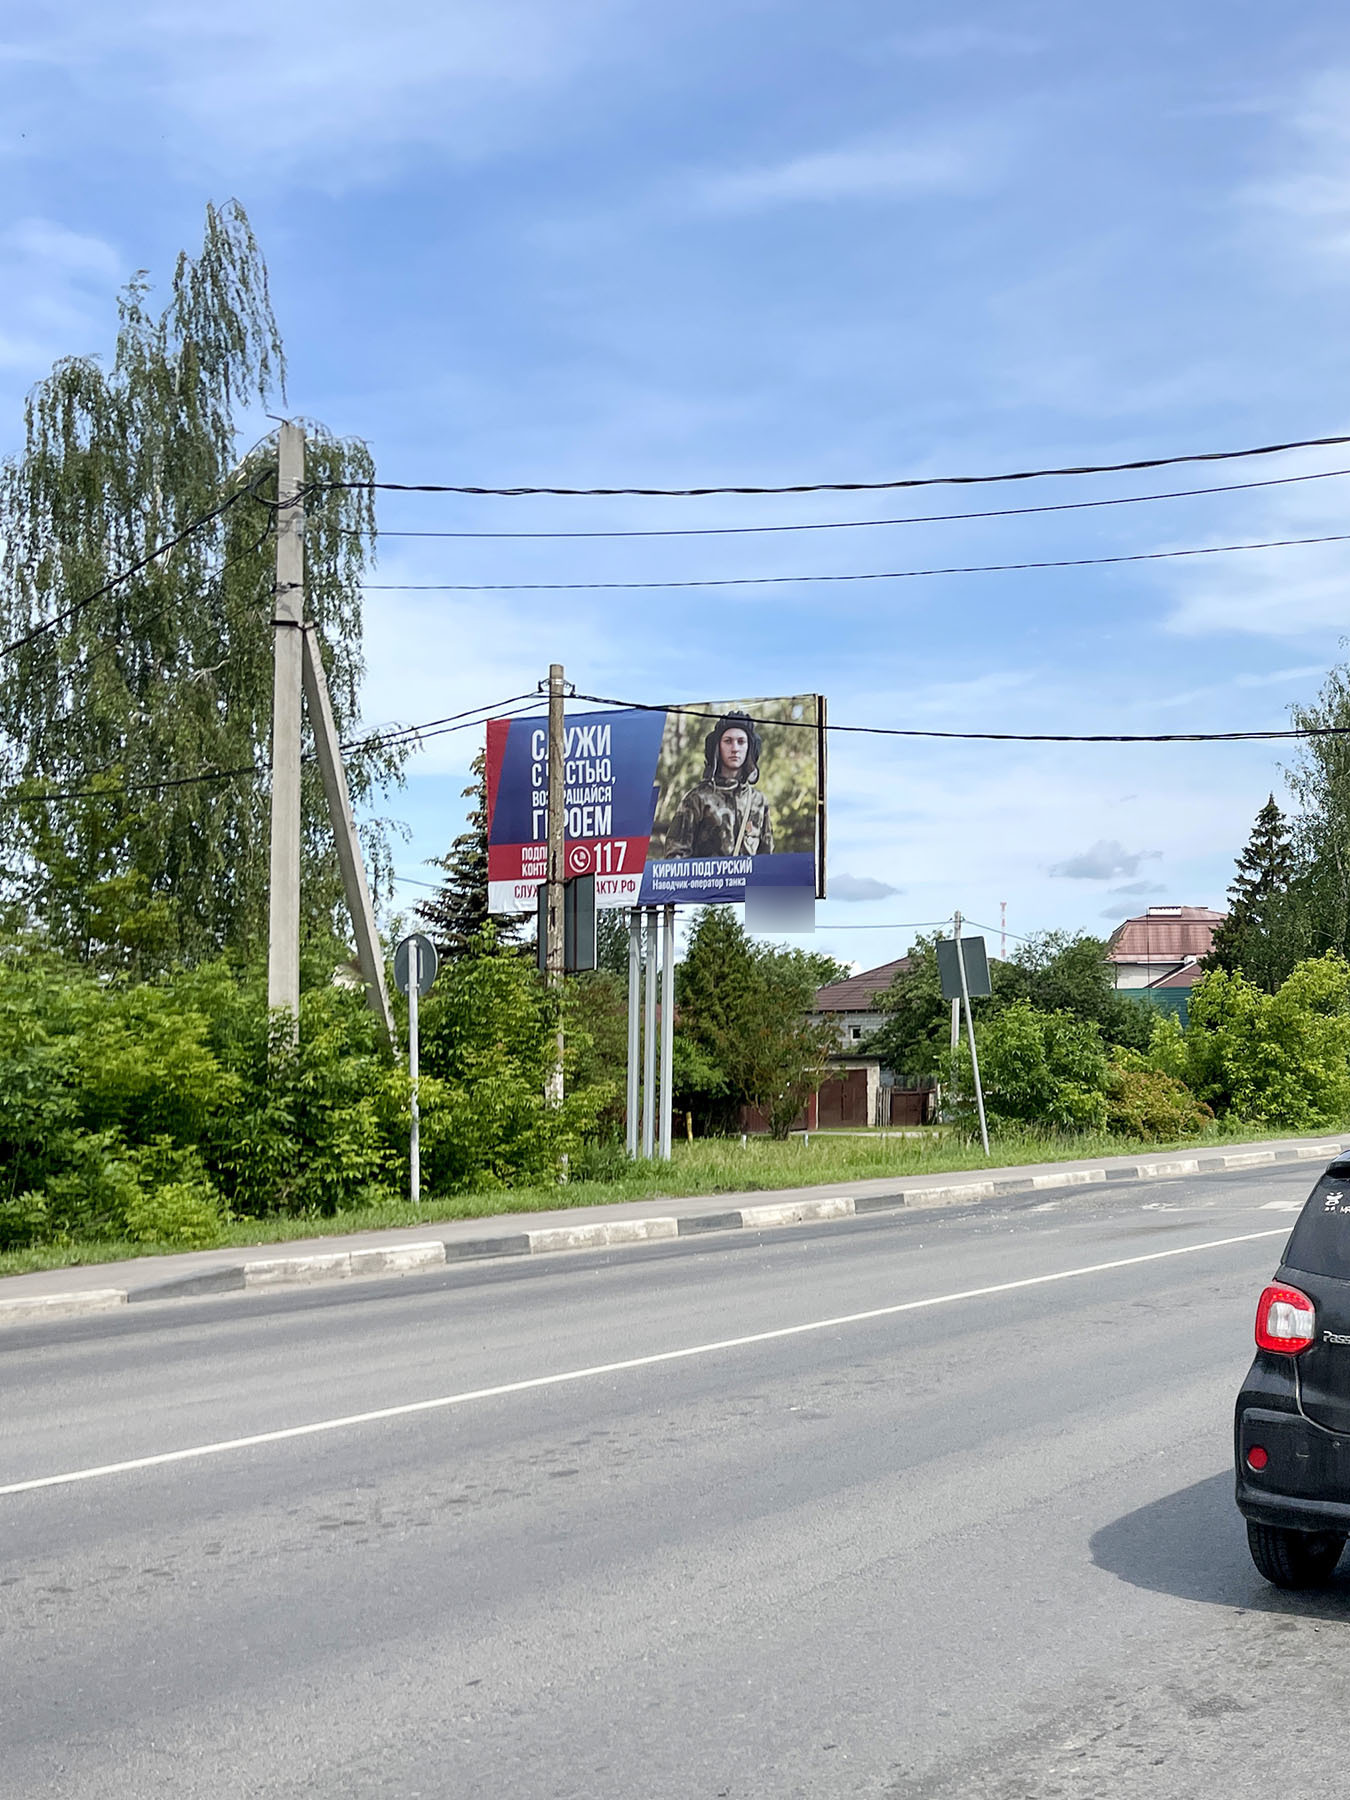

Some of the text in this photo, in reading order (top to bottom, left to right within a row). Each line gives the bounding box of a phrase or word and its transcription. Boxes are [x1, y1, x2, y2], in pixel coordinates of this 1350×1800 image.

[531, 724, 611, 761] СУЖИ
[531, 758, 616, 787] С СТЬЮ,
[532, 784, 612, 807] ВОАЩАЙСЯ
[532, 805, 612, 840] ГОЕМ
[593, 841, 627, 872] 117
[652, 857, 753, 878] КИРИЛЛ ПОДГУРСКИЙ
[652, 876, 746, 891] Наводчик-оператор танка
